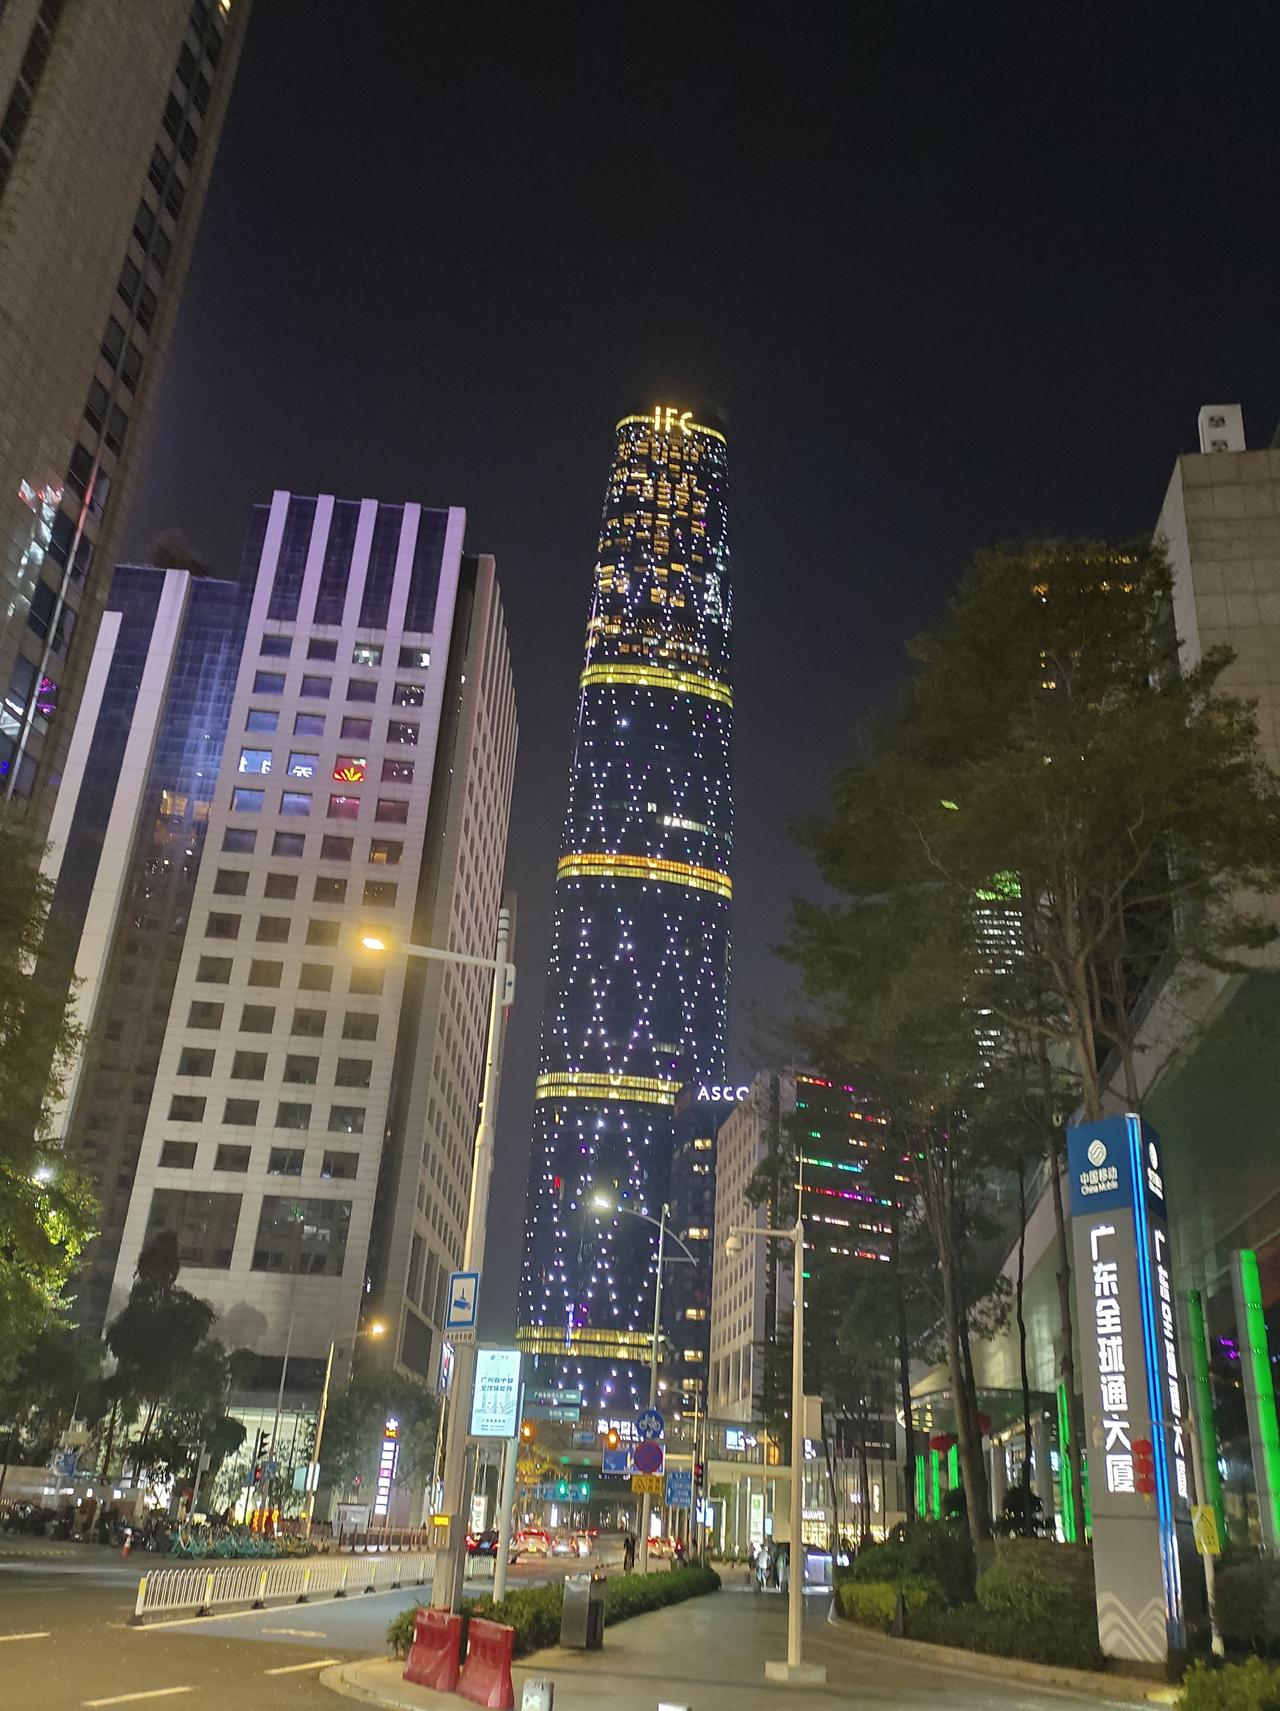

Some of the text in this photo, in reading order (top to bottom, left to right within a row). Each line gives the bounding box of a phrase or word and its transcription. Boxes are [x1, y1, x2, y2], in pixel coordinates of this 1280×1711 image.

[654, 406, 692, 436] IFC
[1080, 1166, 1118, 1185] 中国移动
[1081, 1180, 1118, 1195] China Mobile
[1090, 1225, 1135, 1493] 广东全球通大厦
